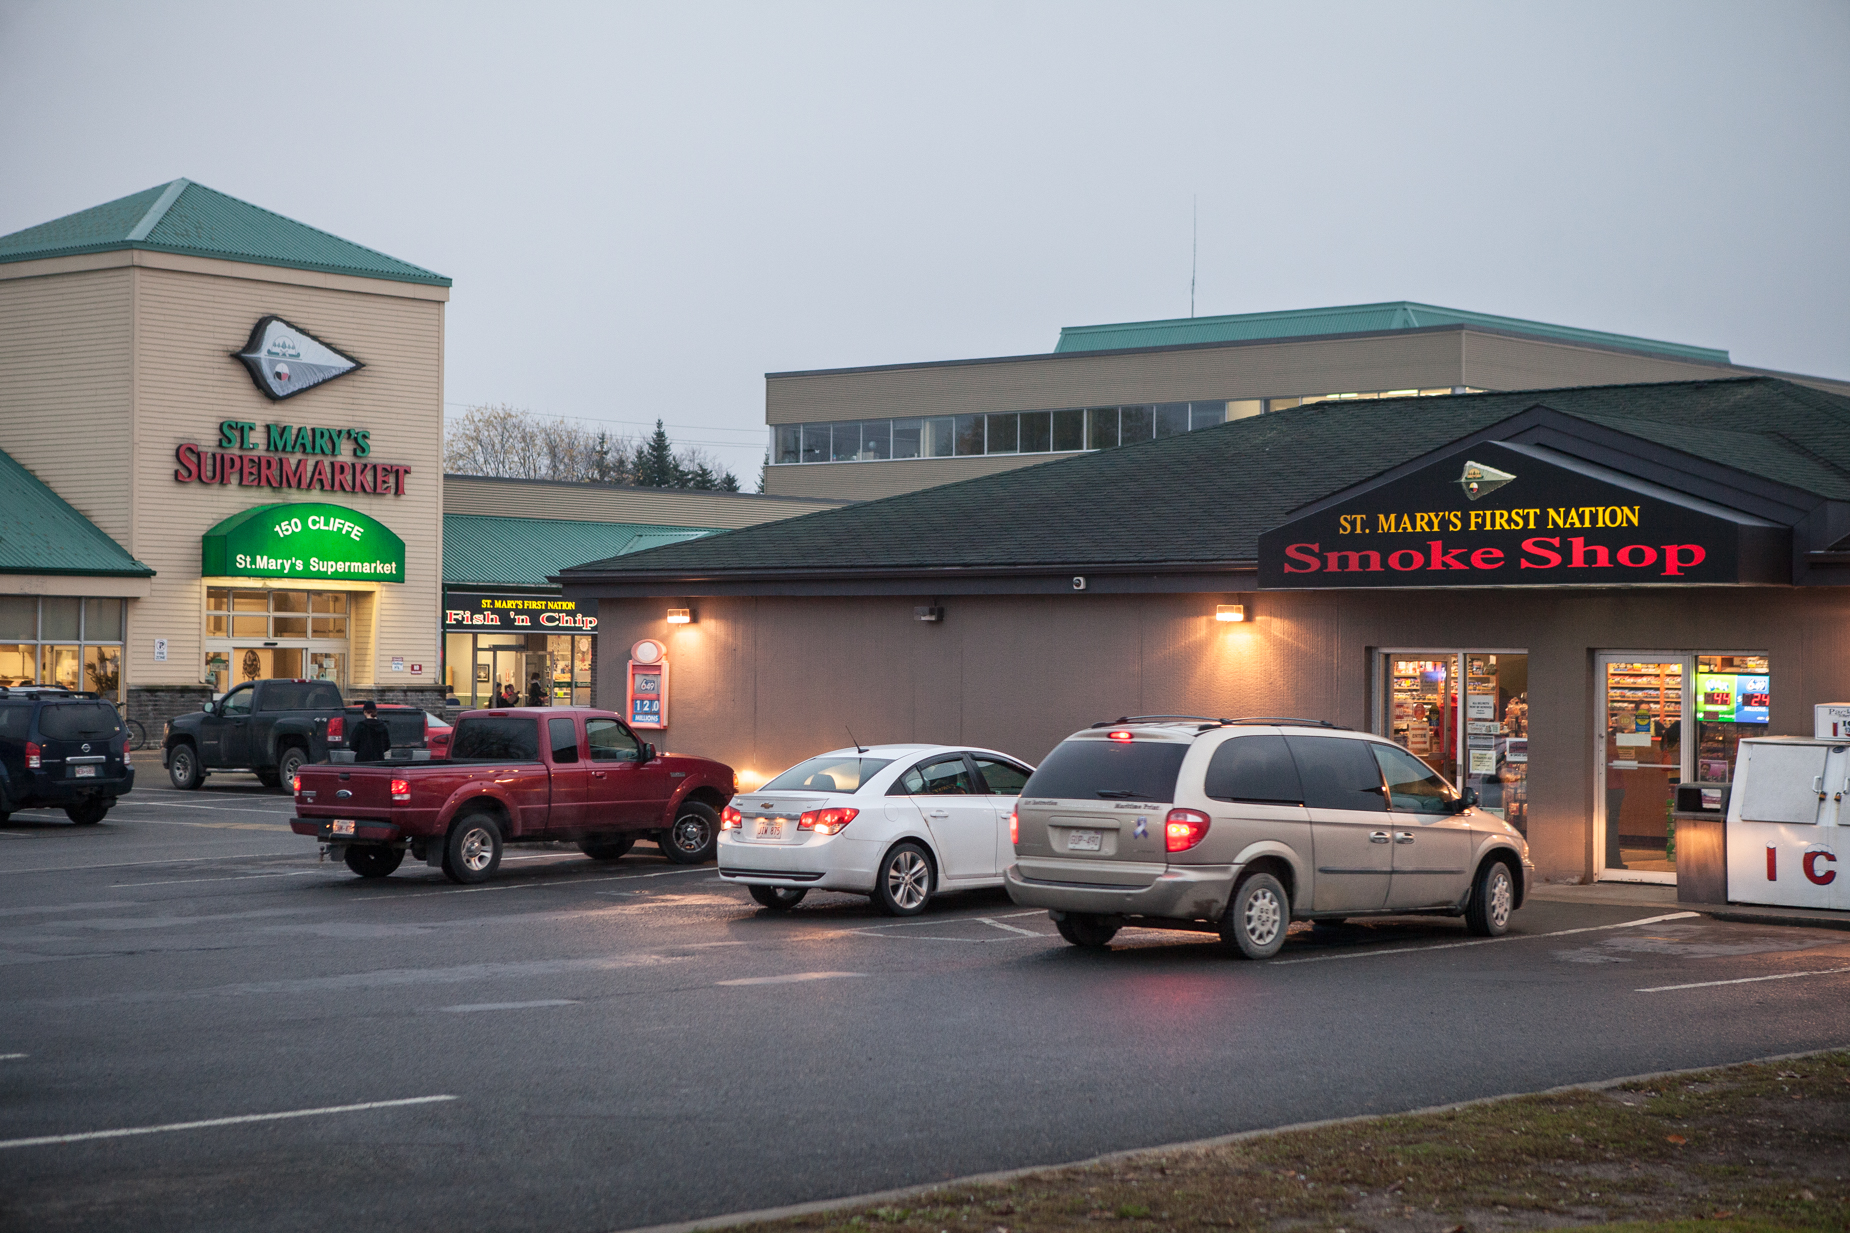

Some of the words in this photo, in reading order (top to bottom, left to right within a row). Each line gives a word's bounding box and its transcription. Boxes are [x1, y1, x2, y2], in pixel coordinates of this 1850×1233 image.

[220, 420, 259, 449] ST.
[266, 424, 371, 458] MARY'S
[175, 443, 412, 495] SUPERMARKET
[1338, 514, 1370, 534] ST.
[1377, 510, 1462, 534] MARY'S
[1468, 508, 1540, 531] FIRST
[1546, 505, 1640, 528] NATION
[274, 518, 302, 538] 150
[308, 516, 364, 542] CLIFFE
[236, 554, 304, 574] St.Mary's
[310, 556, 397, 575] Supermarket
[1283, 540, 1505, 574] Smoke
[1519, 536, 1707, 576] Shop
[481, 598, 493, 609] ST.
[494, 599, 523, 610] MARY'S
[524, 600, 548, 610] FIRST
[548, 600, 576, 610] NATION
[446, 610, 500, 626] Fish
[510, 611, 531, 626] 'n
[1714, 692, 1731, 704] 44
[1751, 693, 1770, 706] 24
[634, 714, 659, 722] MILLIONS
[770, 826, 781, 836] 875
